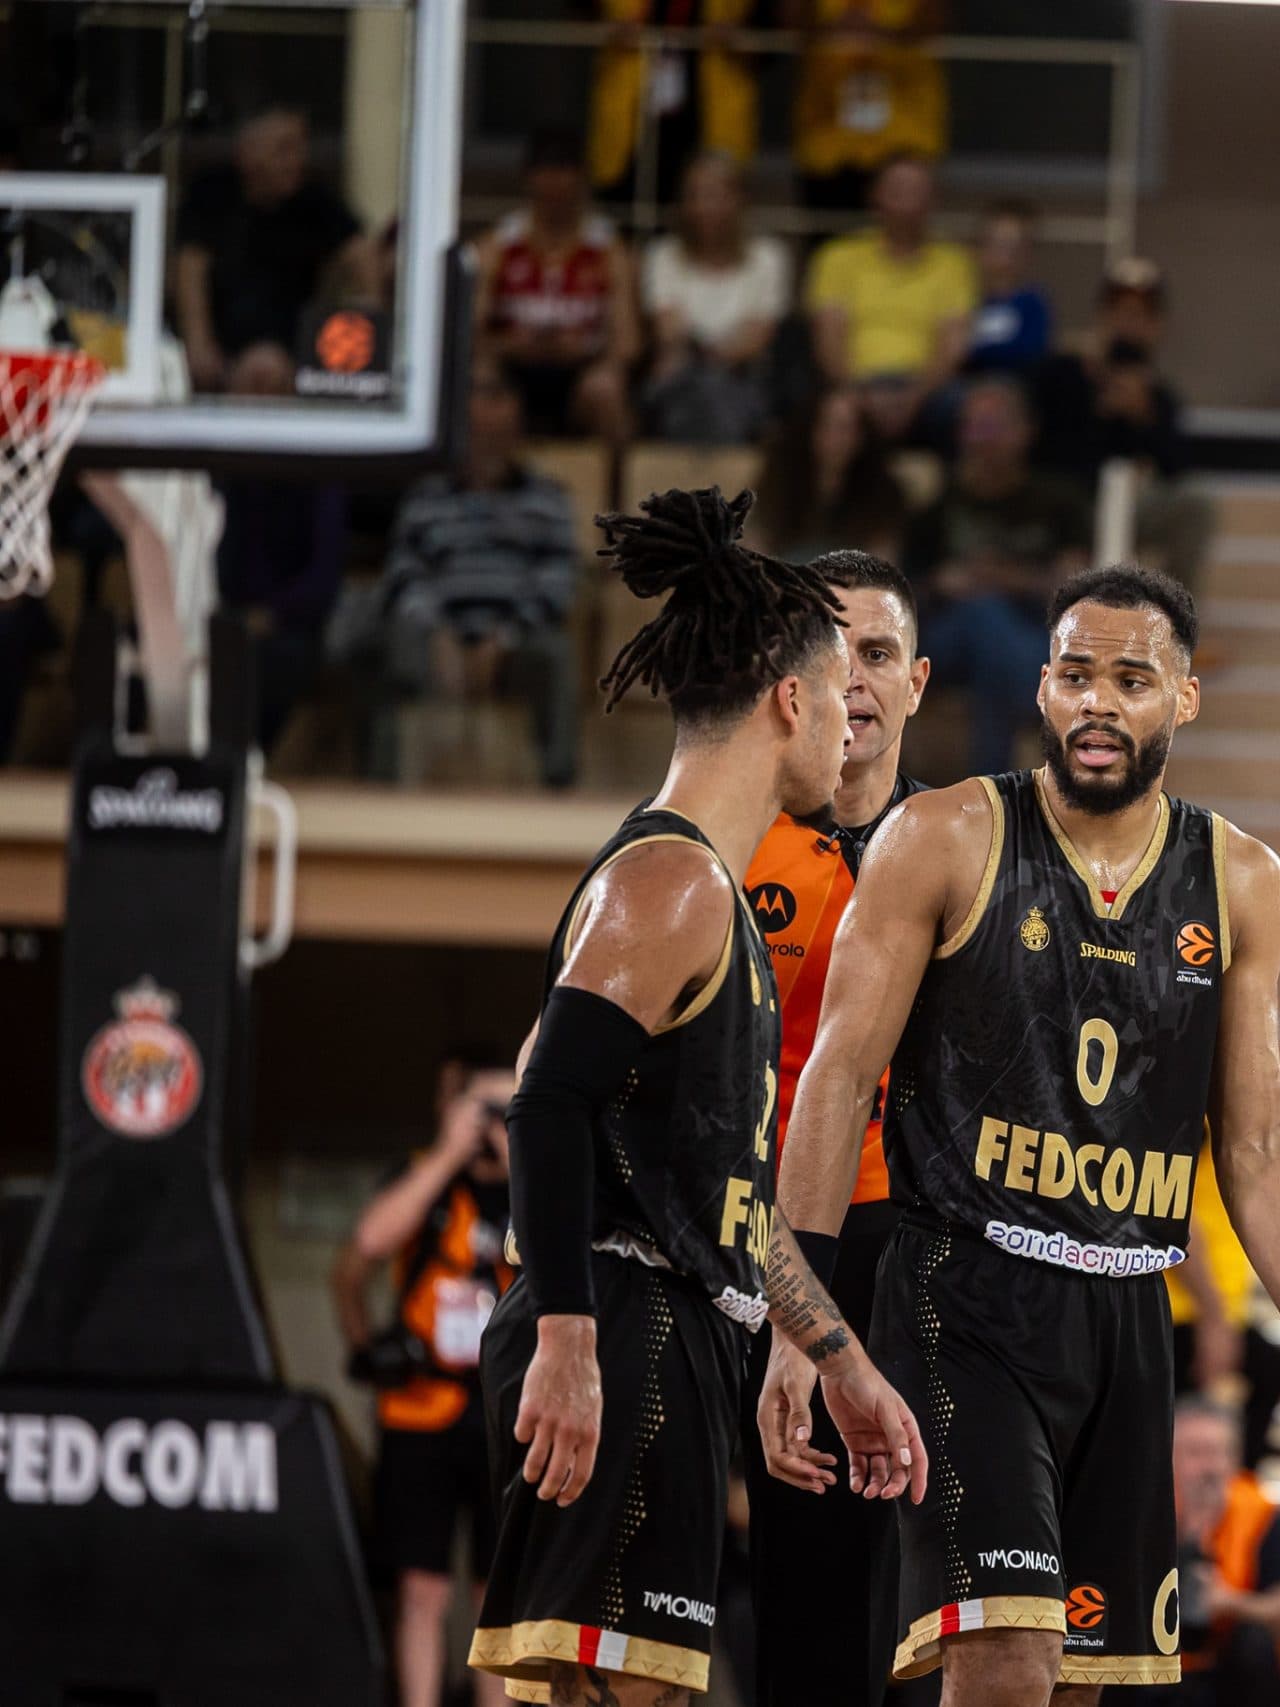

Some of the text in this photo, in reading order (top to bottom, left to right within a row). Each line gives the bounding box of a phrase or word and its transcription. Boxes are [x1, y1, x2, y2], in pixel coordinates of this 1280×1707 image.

[767, 942, 804, 957] rola
[1080, 941, 1136, 967] SPALDING
[1176, 974, 1212, 986] abu dhabi
[1076, 1018, 1118, 1106] 0
[975, 1115, 1193, 1220] FEDCOM
[989, 1224, 1165, 1276] zondacrypto
[0, 1411, 279, 1512] EDCOM
[978, 1549, 1060, 1574] TVMONACO
[1080, 1638, 1104, 1647] dhabi
